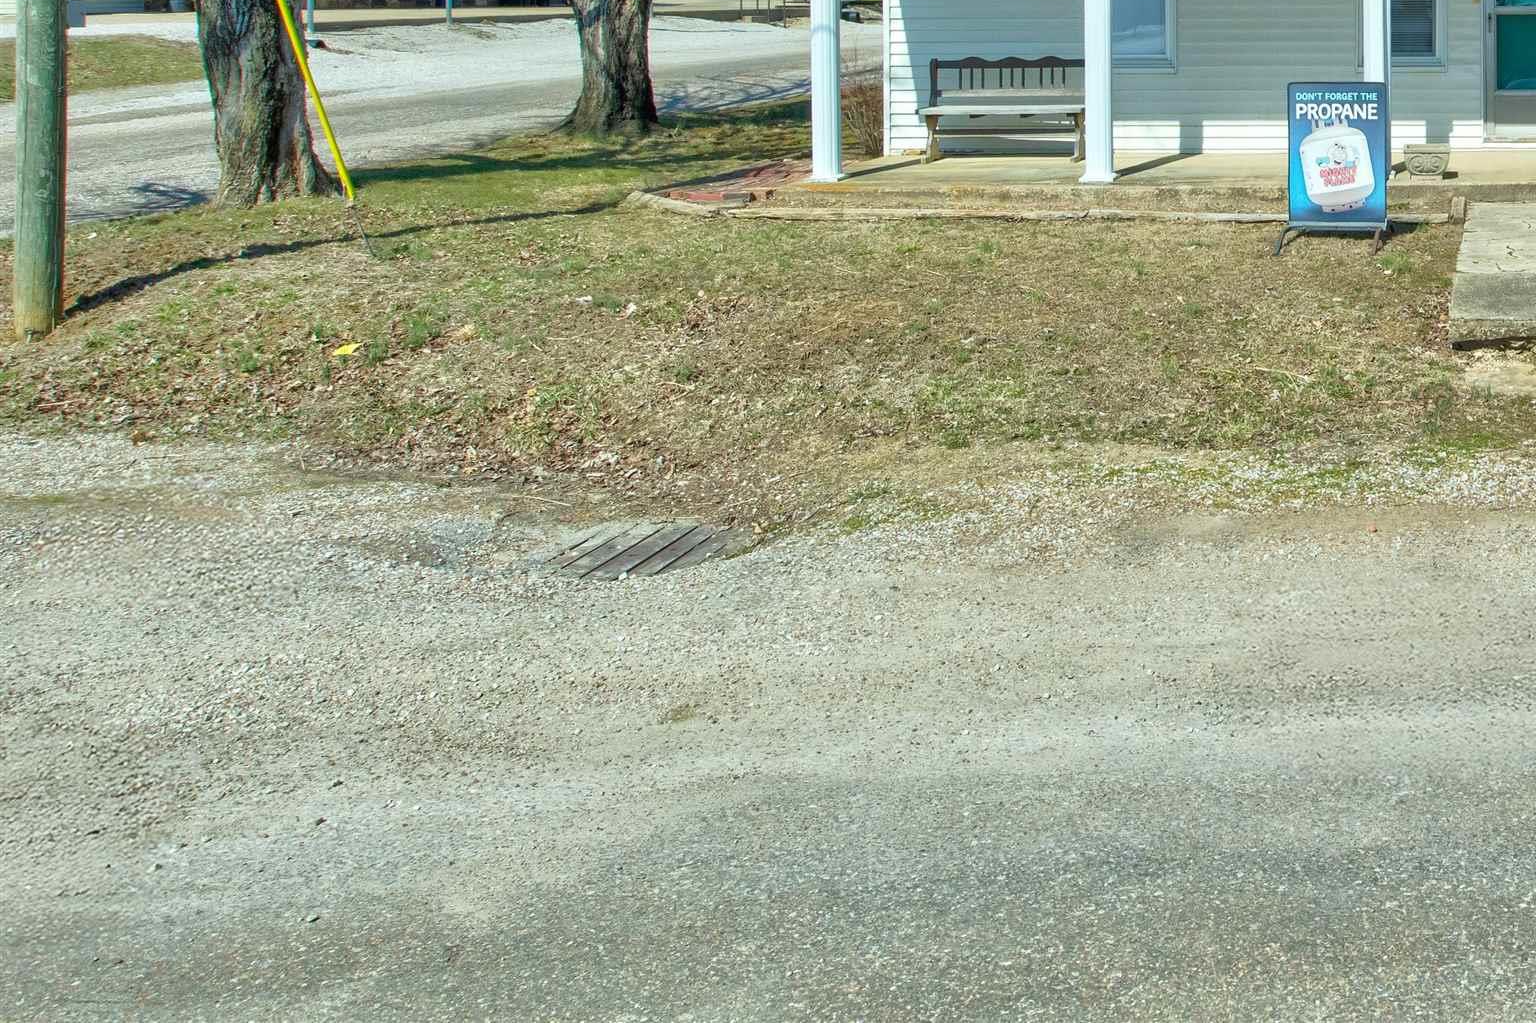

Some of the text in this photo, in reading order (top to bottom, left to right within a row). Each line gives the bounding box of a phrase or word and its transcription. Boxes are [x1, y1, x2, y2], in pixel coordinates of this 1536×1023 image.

[1296, 92, 1378, 101] DON'T FORGET THE
[1295, 103, 1378, 120] PROPANE
